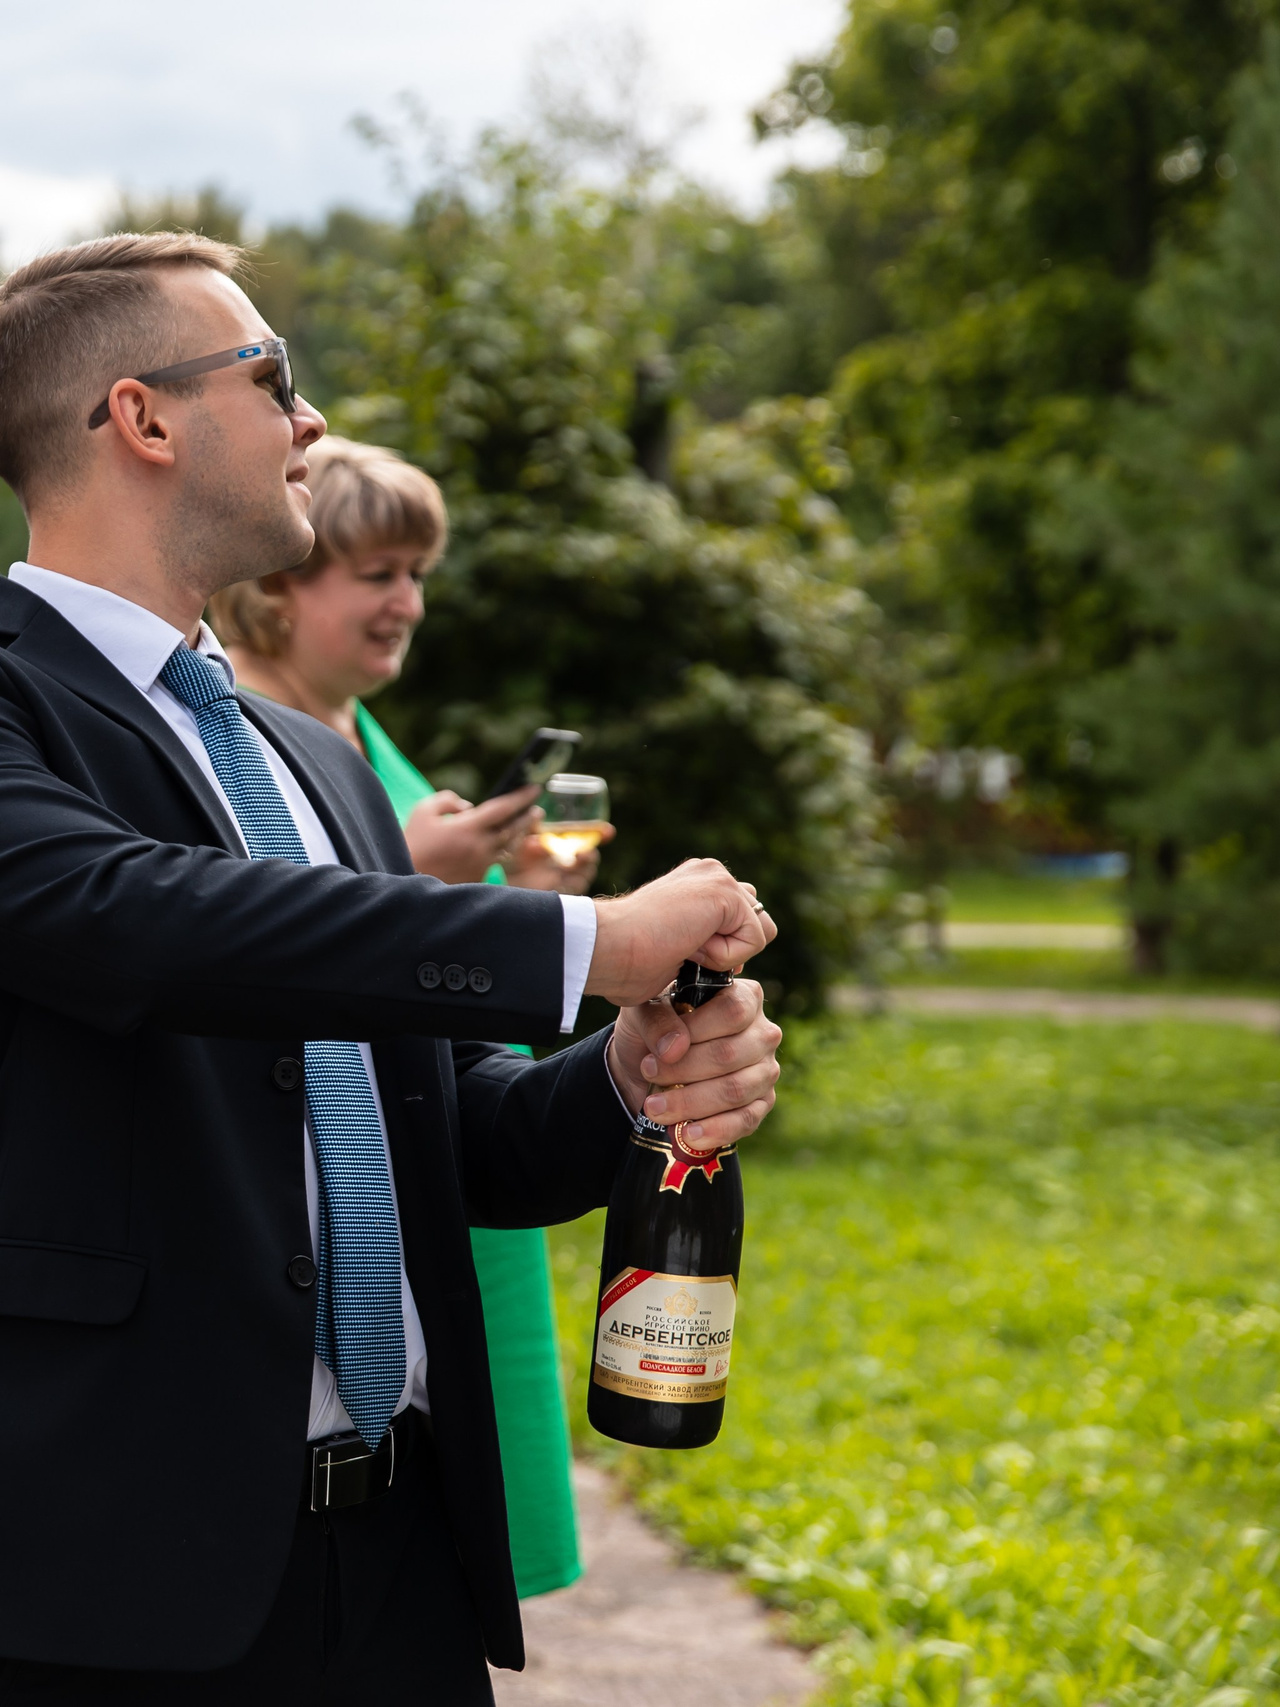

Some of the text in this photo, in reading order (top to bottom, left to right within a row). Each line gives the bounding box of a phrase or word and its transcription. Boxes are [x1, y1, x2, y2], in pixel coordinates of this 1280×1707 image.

[645, 1314, 710, 1325] РОССИЙСКОЕ
[644, 1321, 686, 1332] ИГРИСТОЕ
[609, 1320, 731, 1346] ДЕРБЕНТСКОЕ
[642, 1362, 686, 1373] ПОЛУСЛАДКОЕ
[686, 1365, 703, 1373] БЕЛОЕ
[667, 1385, 692, 1394] ЗАВОД
